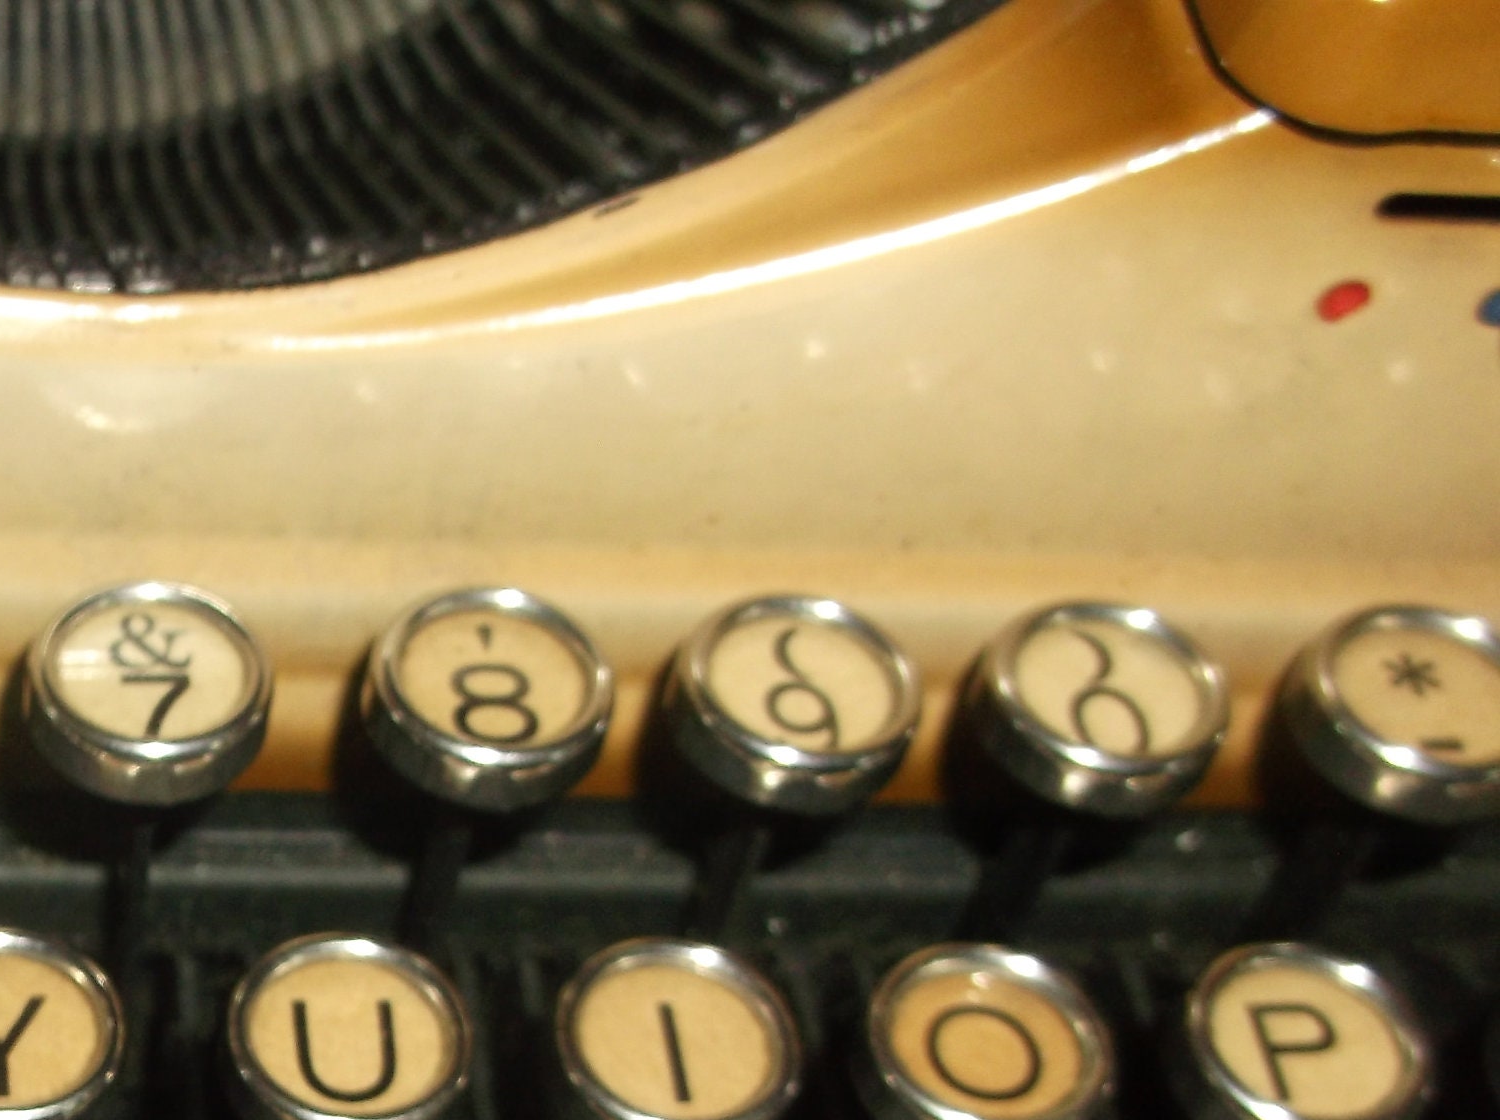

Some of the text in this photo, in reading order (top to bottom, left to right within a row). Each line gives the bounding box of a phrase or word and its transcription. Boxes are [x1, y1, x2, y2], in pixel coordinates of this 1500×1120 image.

[109, 613, 191, 668] &
[121, 674, 190, 738] 7
[451, 662, 540, 745] 8
[292, 1000, 397, 1104] U
[658, 1003, 692, 1104] I
[924, 1005, 1045, 1104] O
[1247, 1003, 1338, 1103] P
